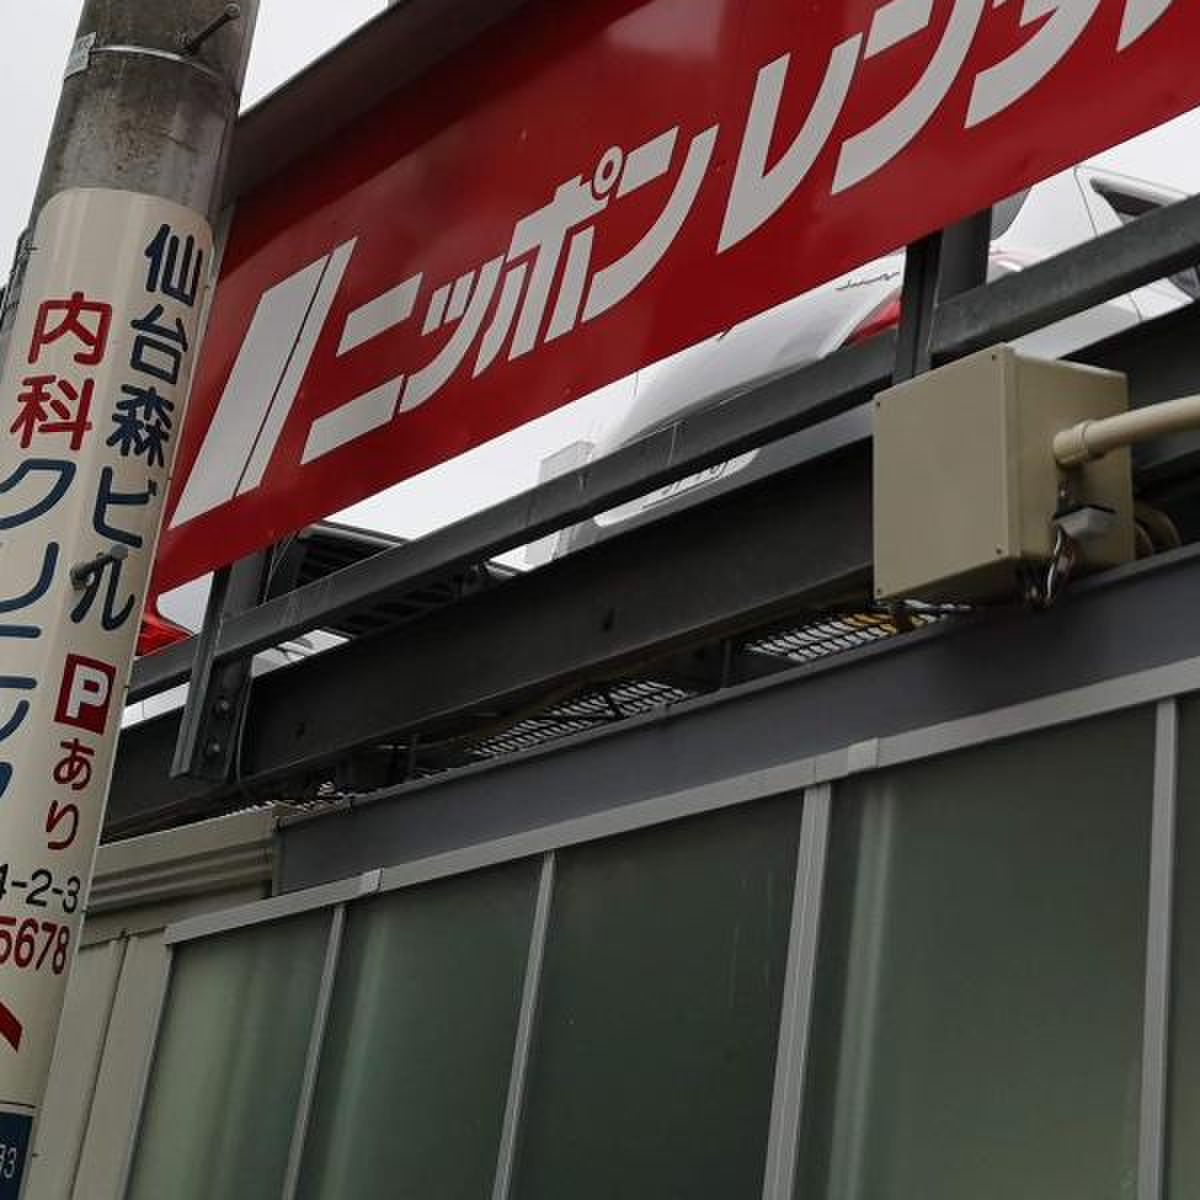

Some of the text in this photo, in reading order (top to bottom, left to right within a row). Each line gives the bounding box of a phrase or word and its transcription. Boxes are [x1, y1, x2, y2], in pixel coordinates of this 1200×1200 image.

[70, 223, 202, 631] 仙台森ビル
